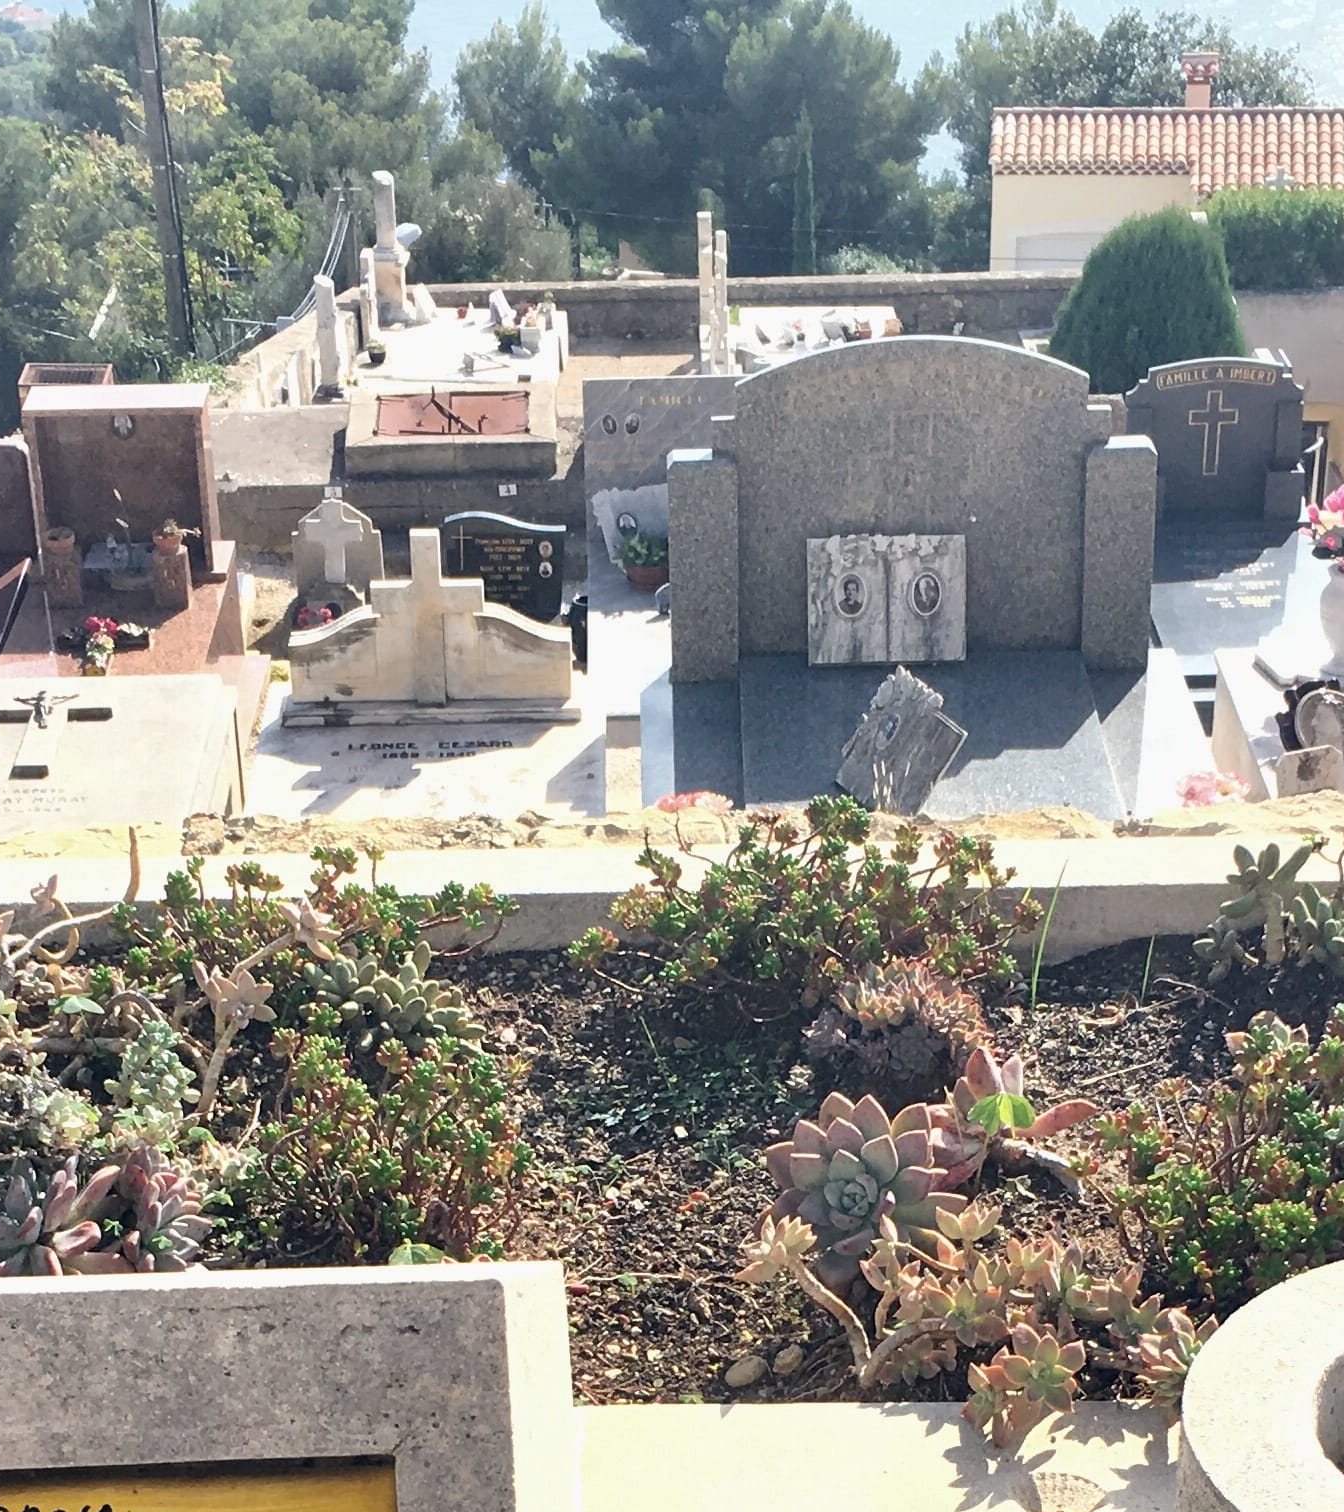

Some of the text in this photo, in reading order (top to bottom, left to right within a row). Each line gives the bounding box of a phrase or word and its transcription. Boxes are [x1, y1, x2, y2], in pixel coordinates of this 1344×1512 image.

[1158, 368, 1208, 387] FAMILLE
[1230, 368, 1273, 383] IMBERT
[348, 742, 419, 751] LEONCE
